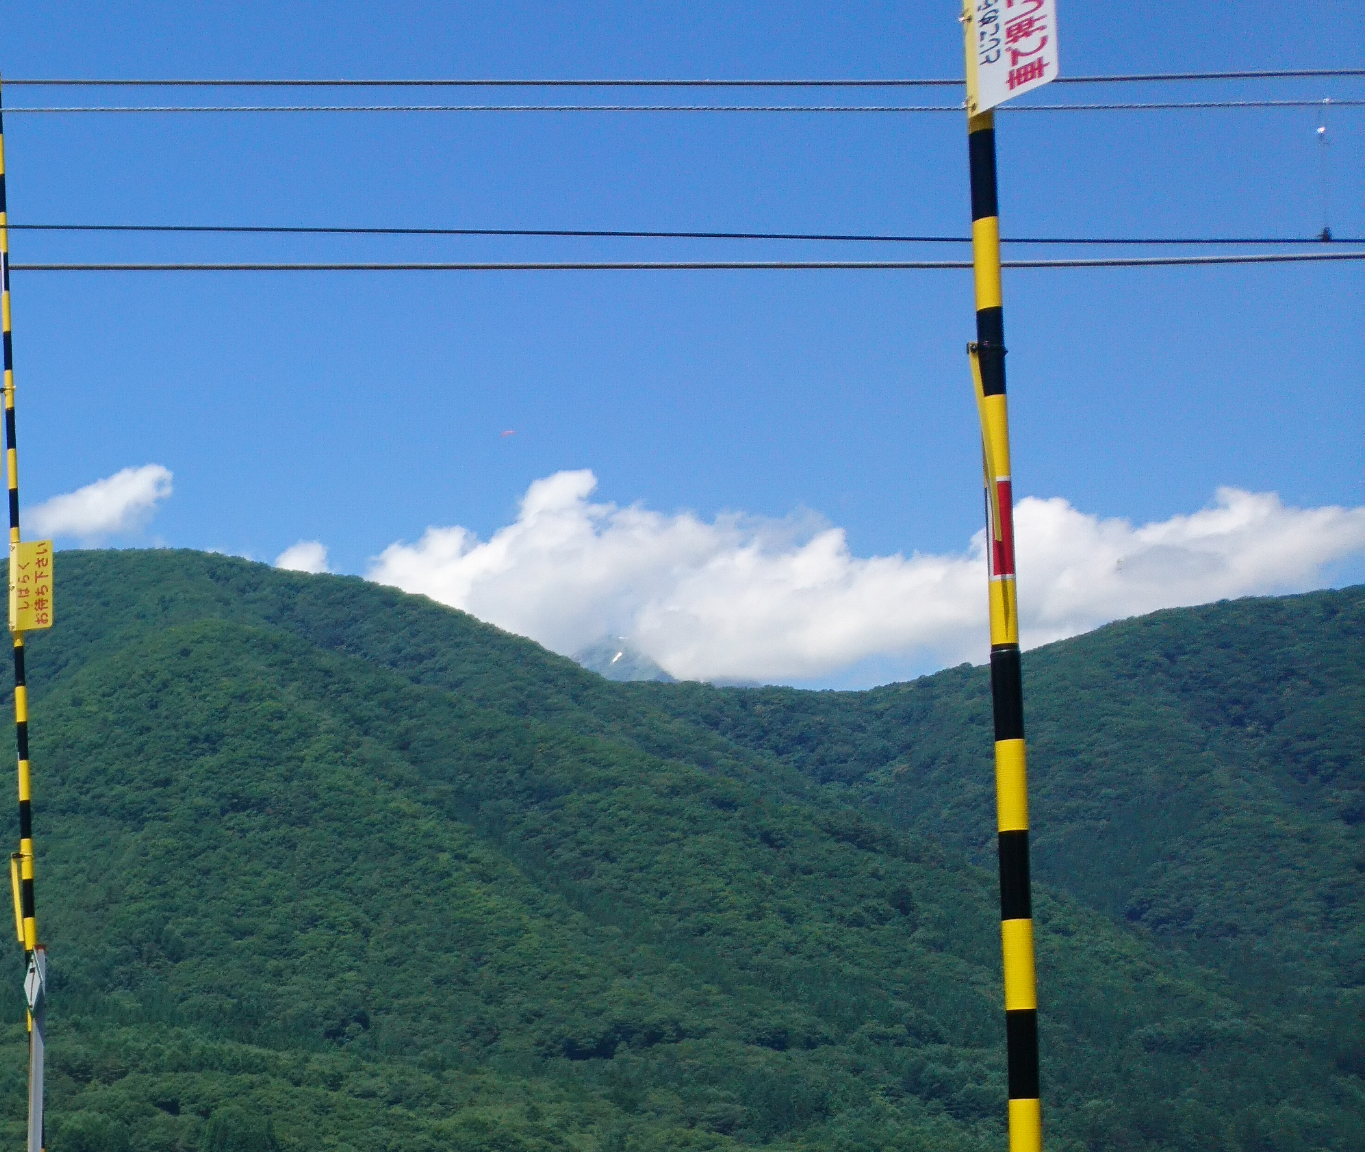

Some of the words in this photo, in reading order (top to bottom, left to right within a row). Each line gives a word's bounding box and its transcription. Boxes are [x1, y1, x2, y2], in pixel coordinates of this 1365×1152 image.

[1004, 0, 1050, 90] 車で押し
[17, 562, 30, 610] しばらく
[34, 542, 49, 625] お待ち下さい
